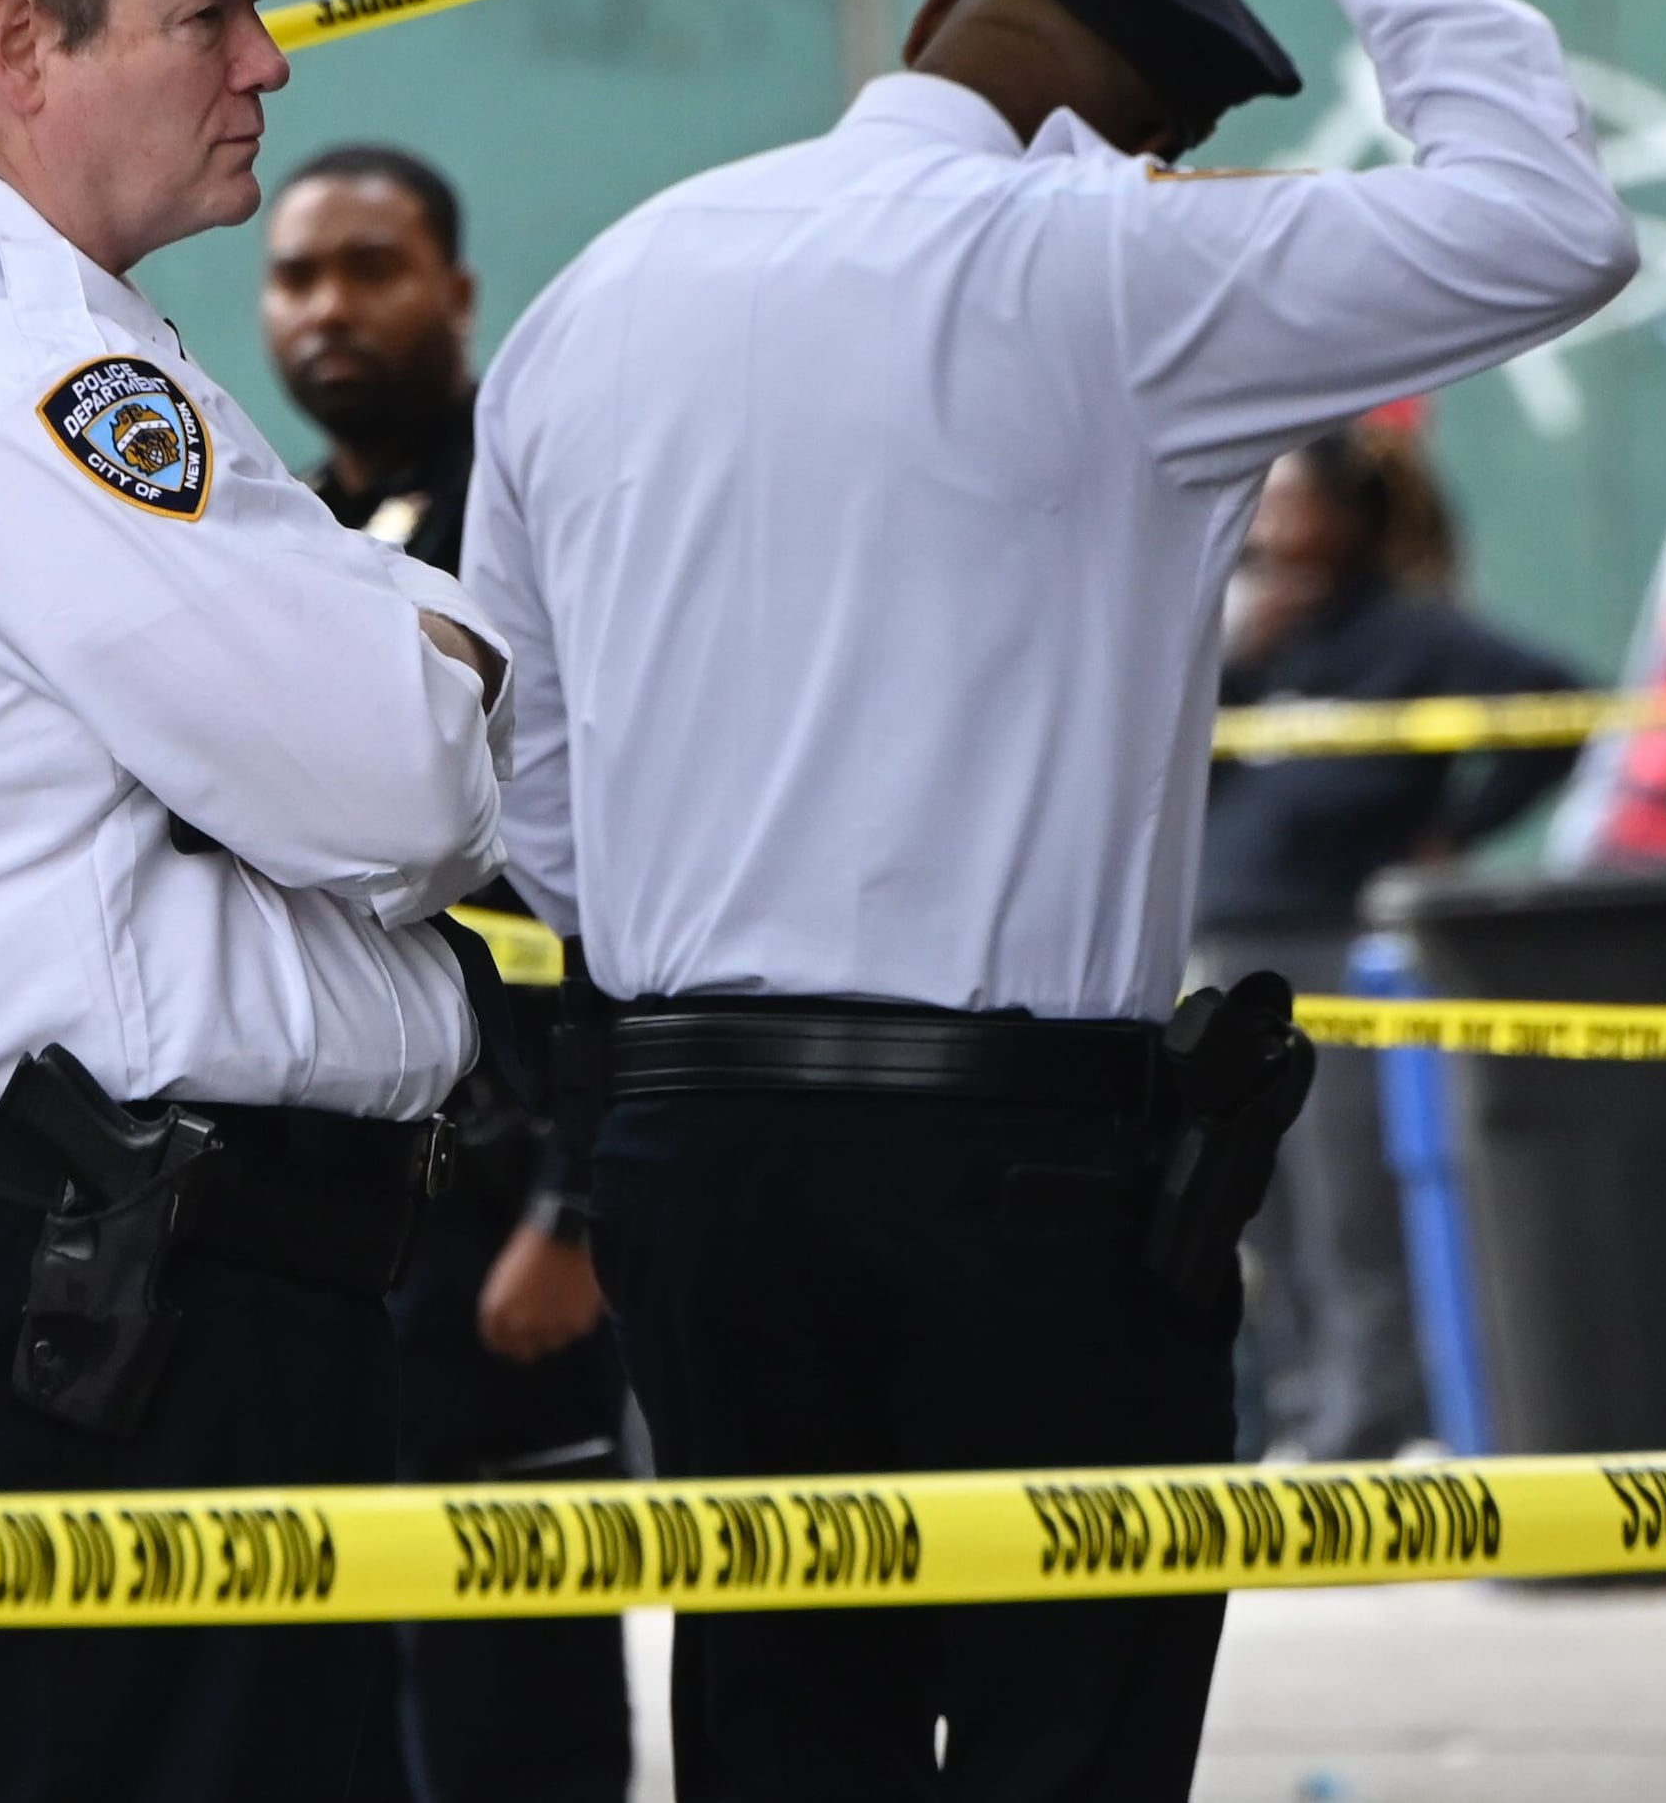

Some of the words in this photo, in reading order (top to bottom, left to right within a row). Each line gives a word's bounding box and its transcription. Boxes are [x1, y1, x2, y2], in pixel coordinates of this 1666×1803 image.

[63, 377, 169, 439] DEPARTMENT
[71, 363, 137, 401] POLICE
[175, 401, 200, 446] YORK
[87, 452, 132, 487] CITY
[135, 482, 162, 500] OF
[184, 450, 201, 490] NEW
[61, 1511, 116, 1605] DO
[121, 1509, 204, 1604] LINE
[207, 1508, 337, 1602] POLICE
[444, 1501, 569, 1594] CROSS
[573, 1500, 644, 1591] NOT
[648, 1497, 701, 1588] DO
[704, 1494, 791, 1588] LINE
[792, 1491, 921, 1586] POLICE
[1024, 1483, 1151, 1574] CROSS
[1153, 1482, 1227, 1571] NOT
[1228, 1480, 1285, 1567] DO
[1283, 1477, 1373, 1567] LINE
[1371, 1473, 1501, 1563] POLICE
